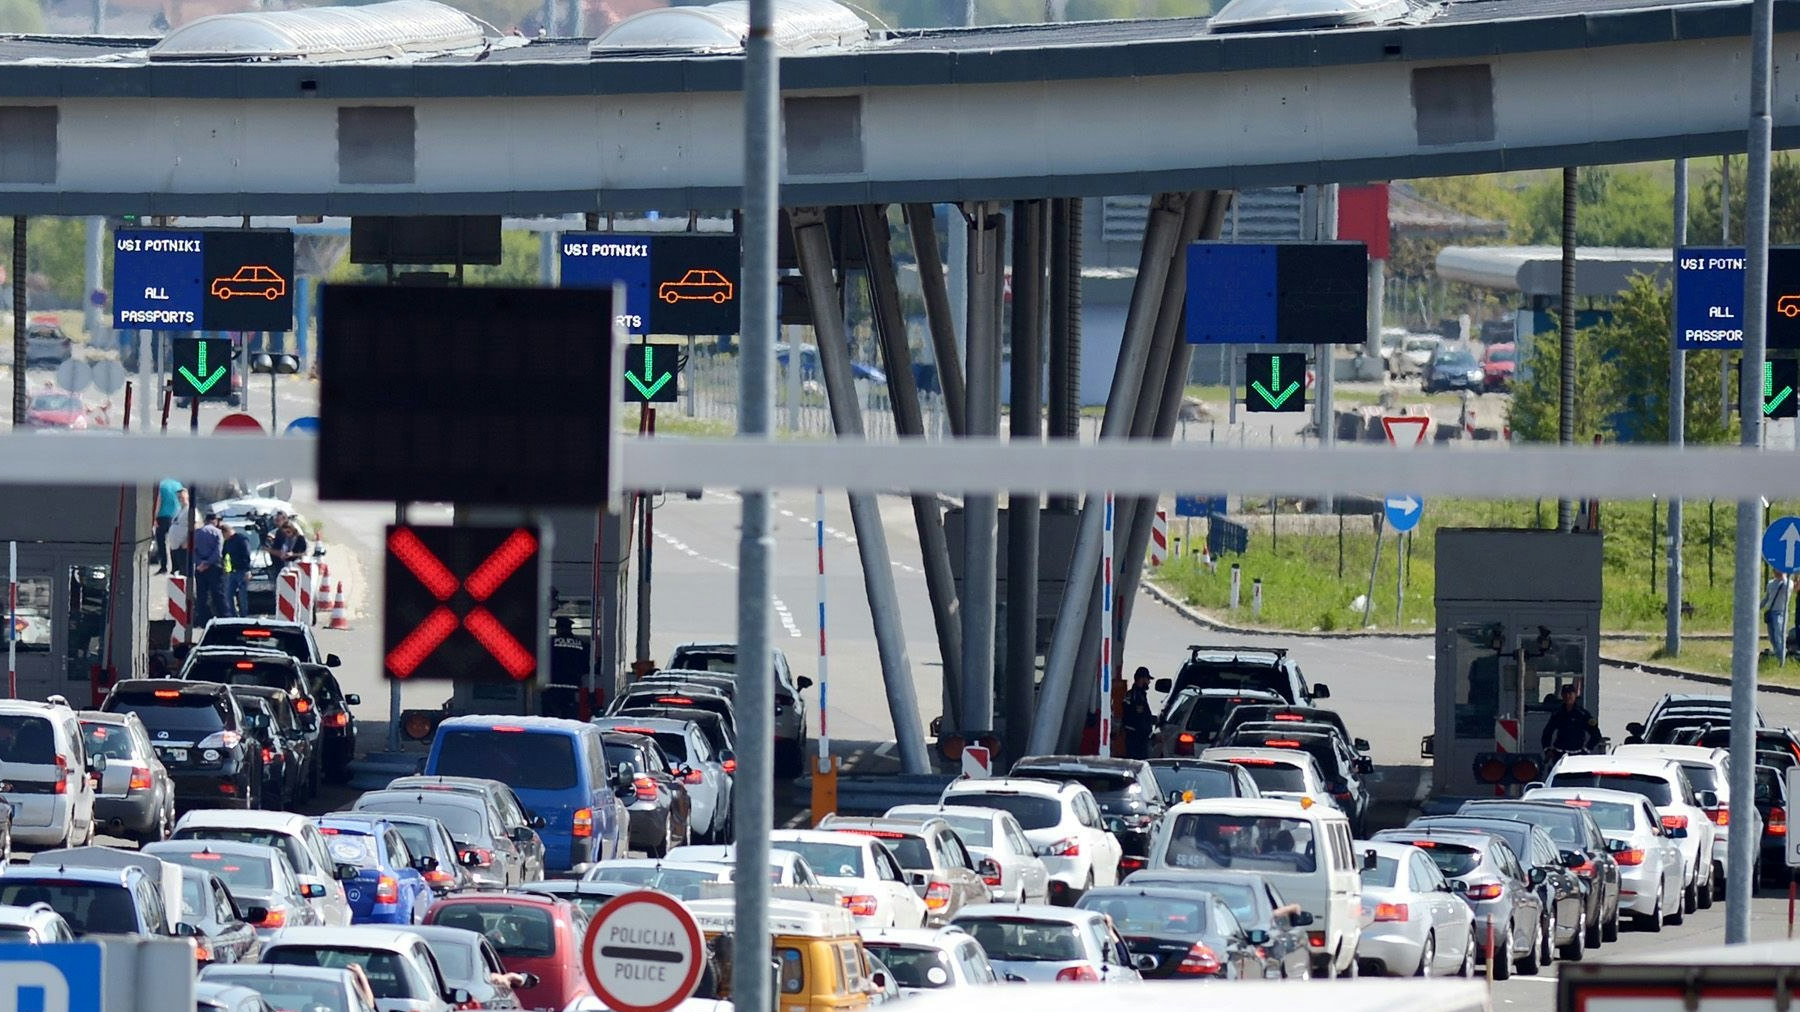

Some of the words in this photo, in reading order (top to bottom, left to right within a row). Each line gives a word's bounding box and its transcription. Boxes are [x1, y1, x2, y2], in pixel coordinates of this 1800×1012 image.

[145, 240, 200, 252] POTNIKI
[592, 244, 648, 257] POTNIKI
[1708, 259, 1747, 270] POTN
[145, 287, 169, 299] ALL
[121, 310, 194, 323] PASSPORTS
[1709, 306, 1734, 318] ALL
[1685, 329, 1743, 341] PASSPOR
[610, 926, 676, 946] POLICIJA
[615, 962, 666, 982] POLICE
